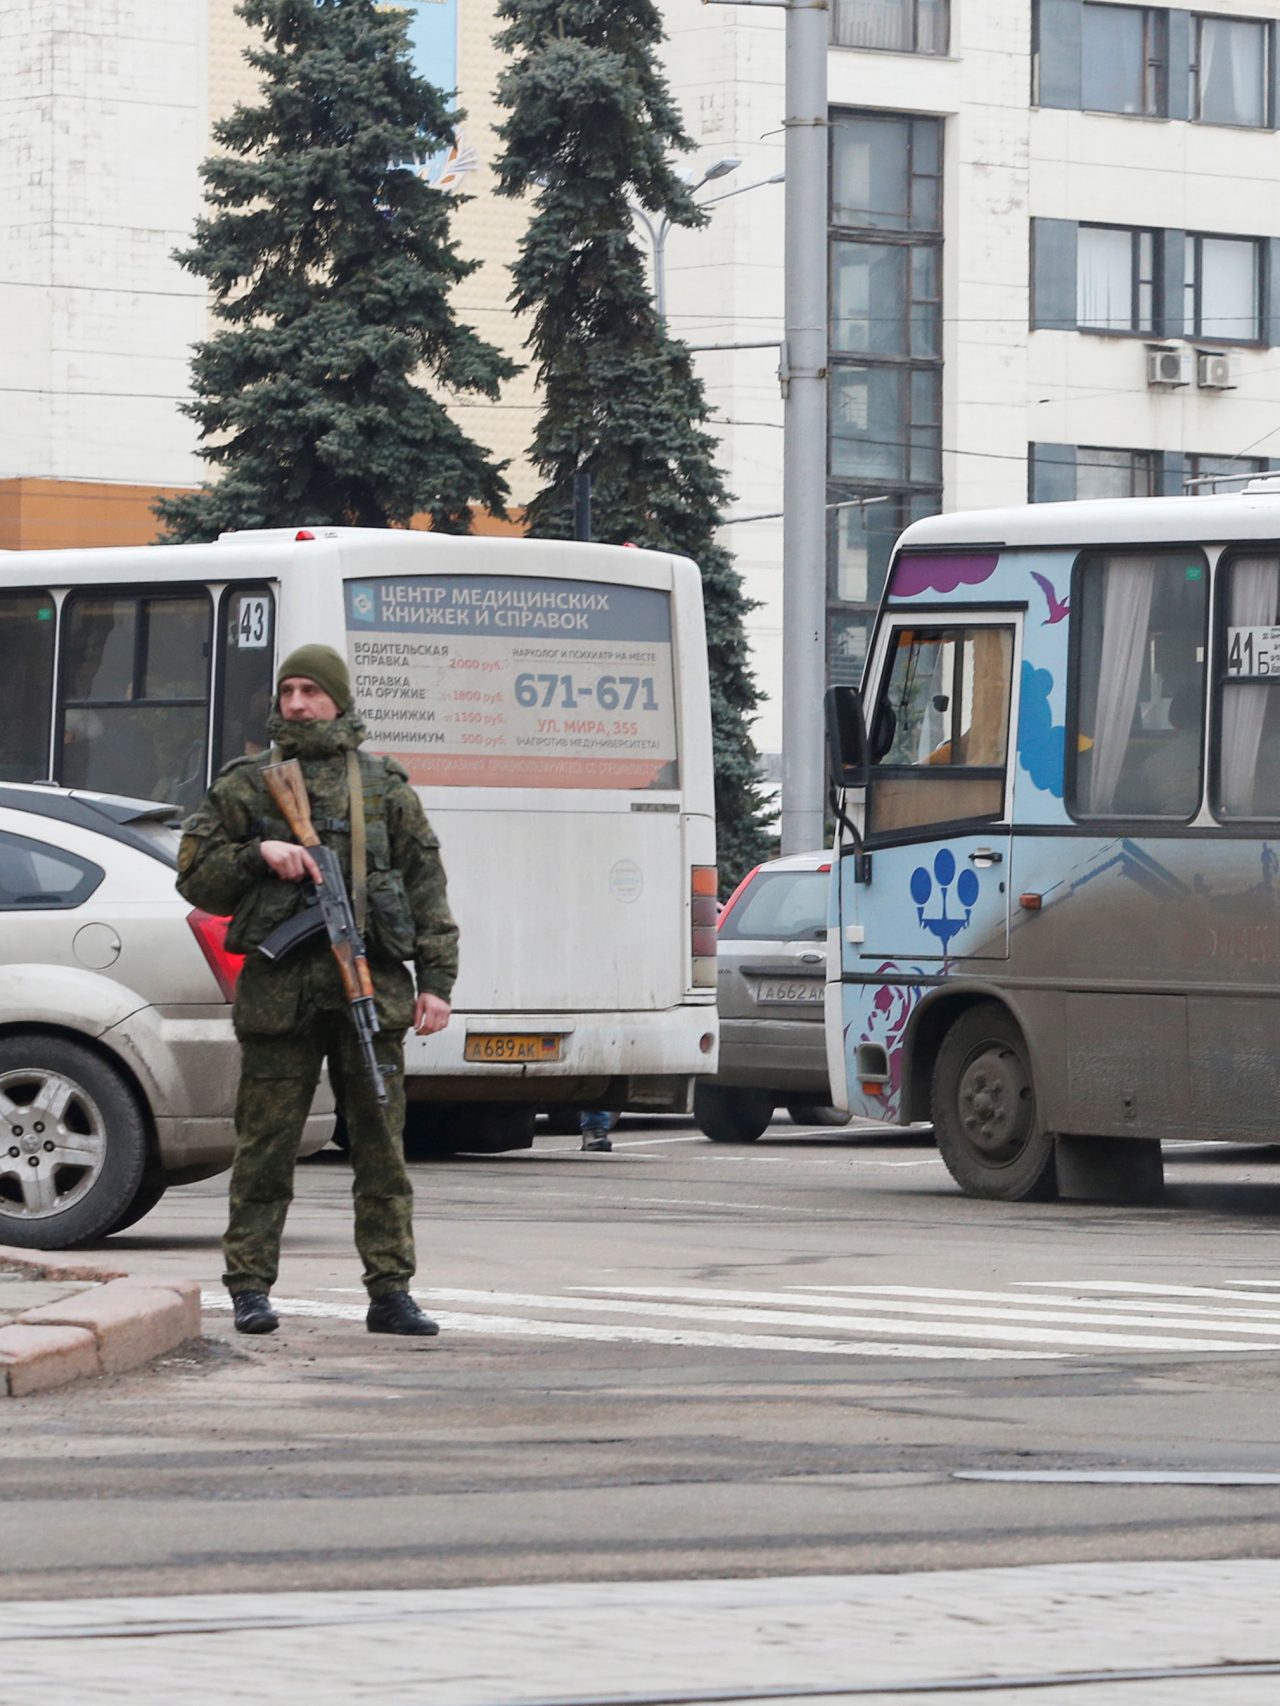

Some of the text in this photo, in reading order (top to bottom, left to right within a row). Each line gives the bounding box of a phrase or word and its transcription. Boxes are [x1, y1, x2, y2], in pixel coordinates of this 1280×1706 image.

[381, 585, 610, 611] ЦЕНТР МЕДИЦИНСКИХ
[240, 602, 264, 642] 43
[382, 606, 590, 630] КНИЖЕК И СПРАВОК
[354, 642, 449, 657] ВОДИТЕЛЬСКАЯ
[512, 648, 558, 659] НАРКОЛОГ
[615, 652, 627, 661] НА
[628, 652, 657, 662] МЕСТЕ
[354, 655, 504, 673] СПРАВКА 2000 руб.
[355, 675, 411, 687] СПРАВКА
[356, 687, 373, 698] НА
[375, 688, 426, 699] ОРУЖИЕ
[514, 672, 659, 711] 671-671
[357, 708, 435, 722] МЕДКНИЖКИ
[537, 719, 638, 737] УЛ. МИРА, 355
[366, 731, 445, 744] АНМИНИМУМ
